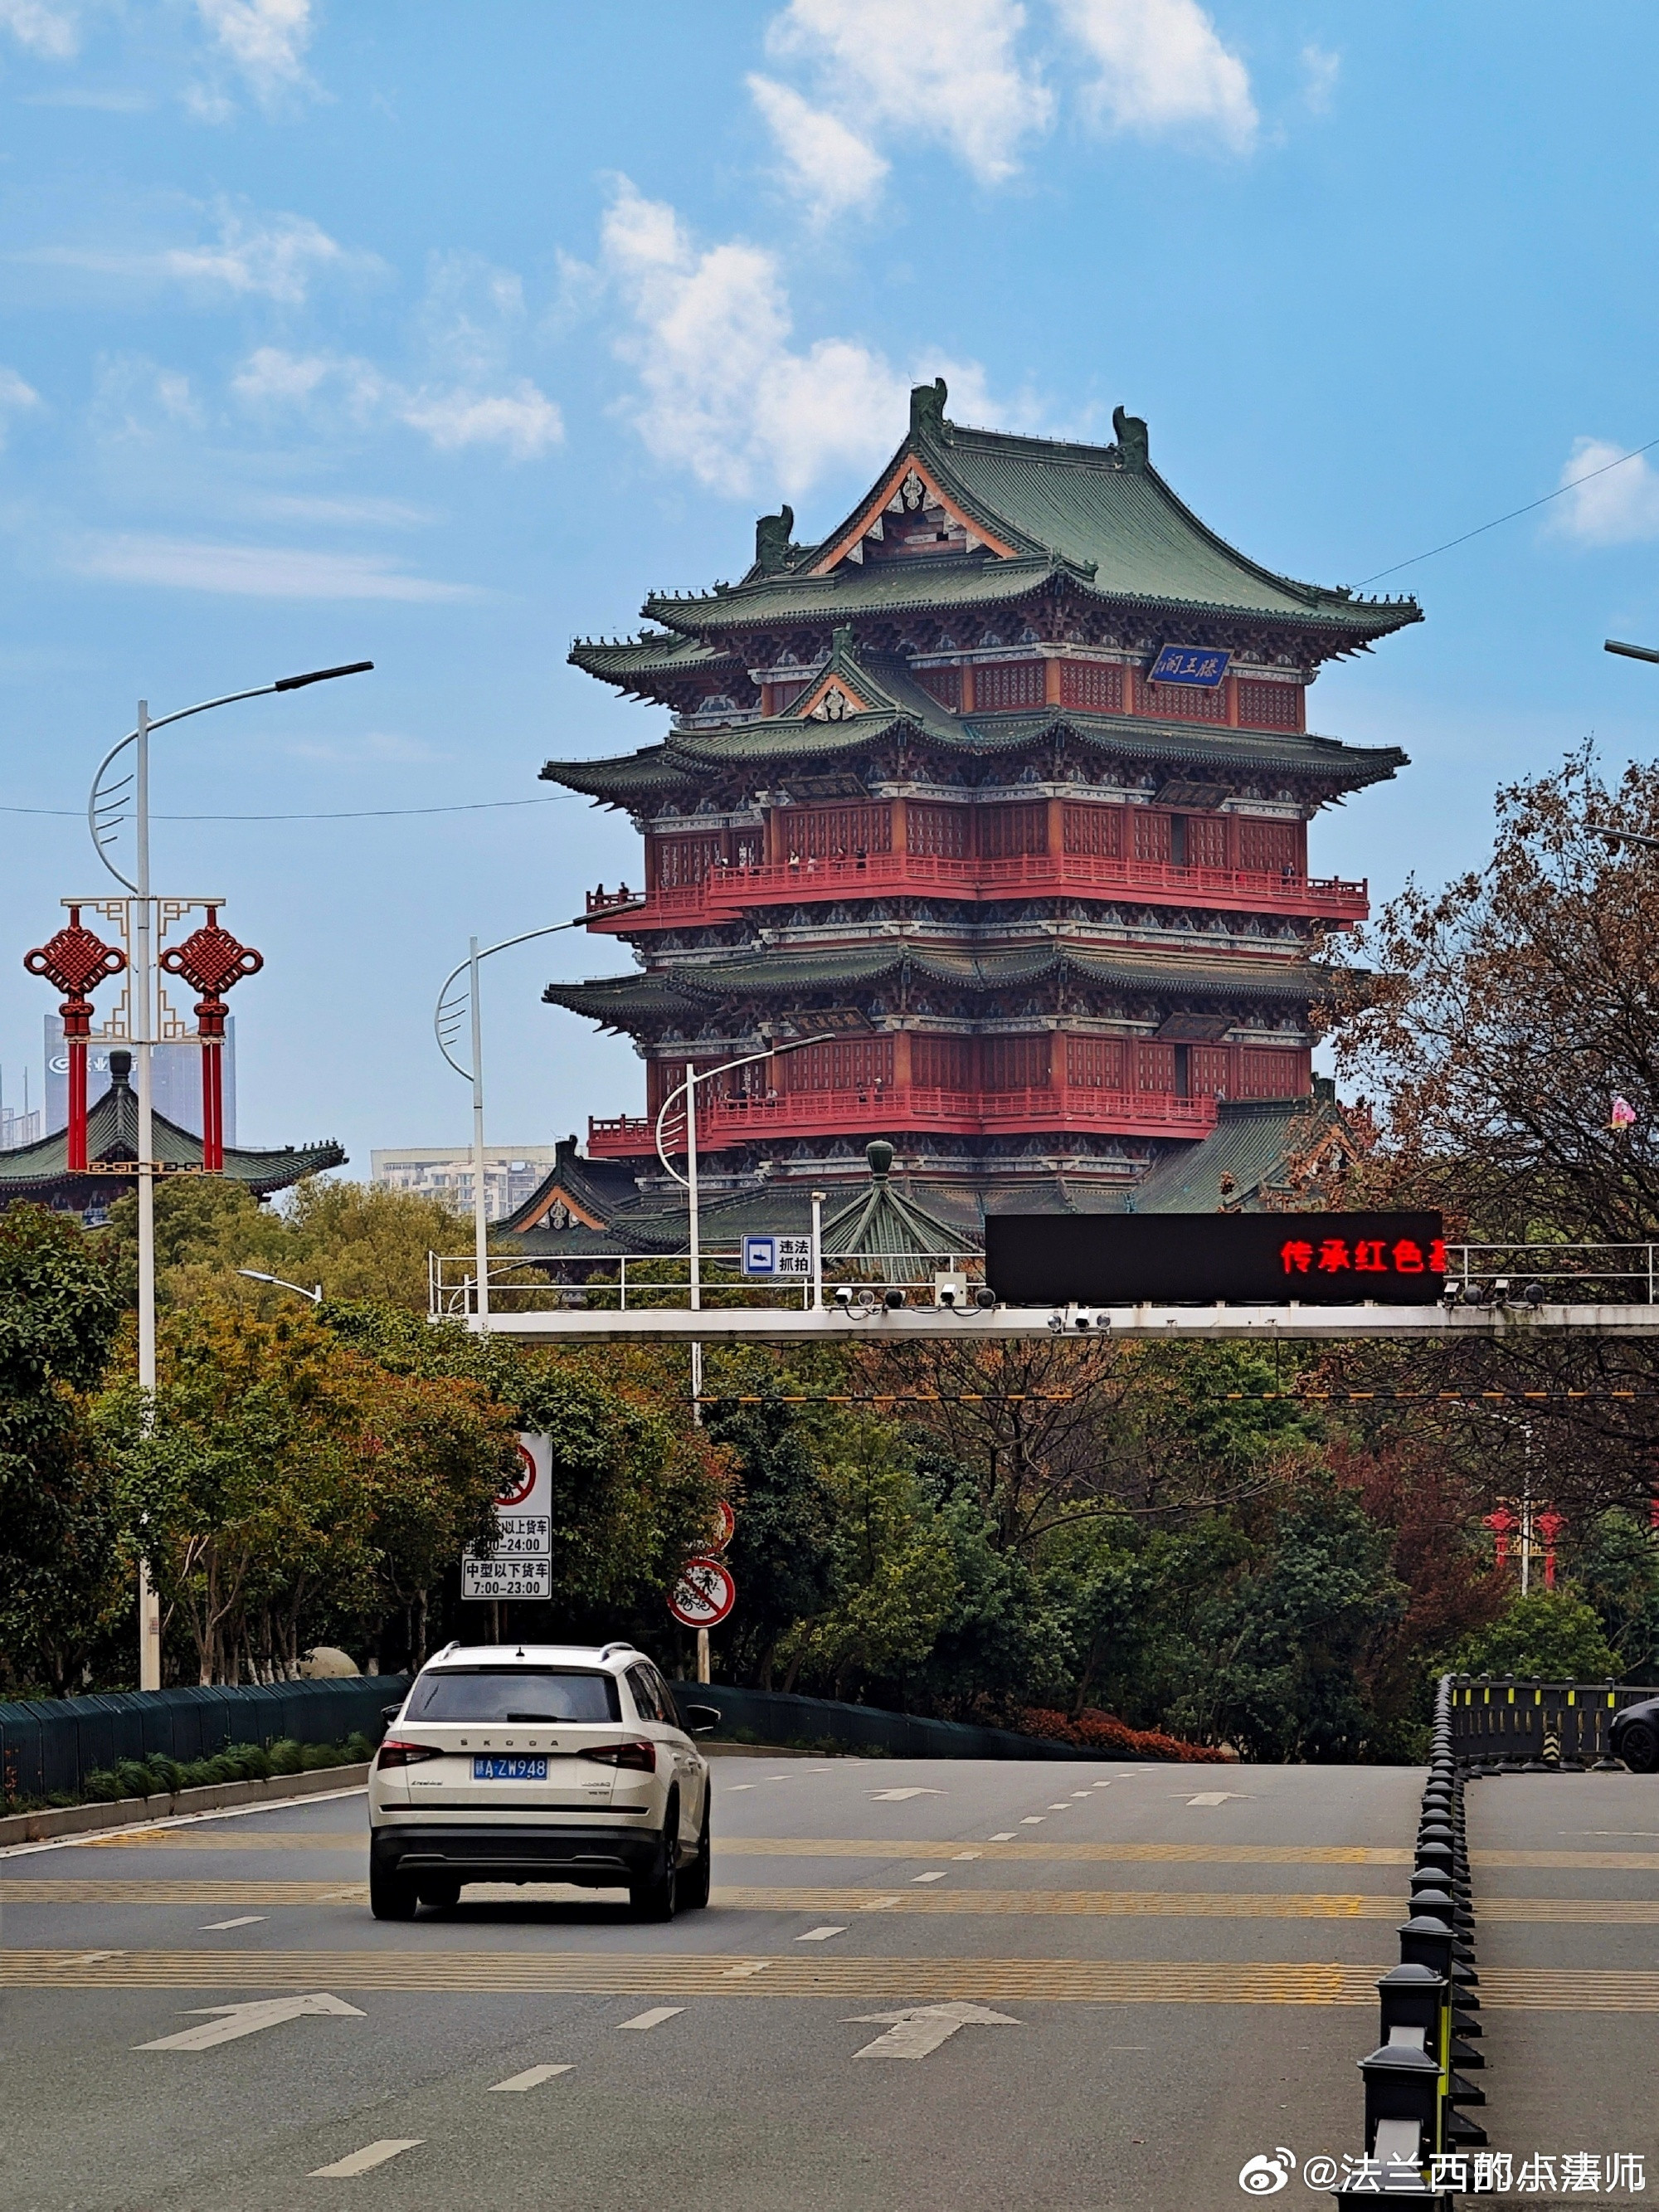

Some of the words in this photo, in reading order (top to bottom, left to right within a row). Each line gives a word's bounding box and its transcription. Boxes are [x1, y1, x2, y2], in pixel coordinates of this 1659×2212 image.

[779, 1240, 809, 1254] 违法
[779, 1257, 809, 1271] 抓拍
[466, 1562, 548, 1578] 中型以下货车
[474, 1581, 540, 1594] 7:00-23:00
